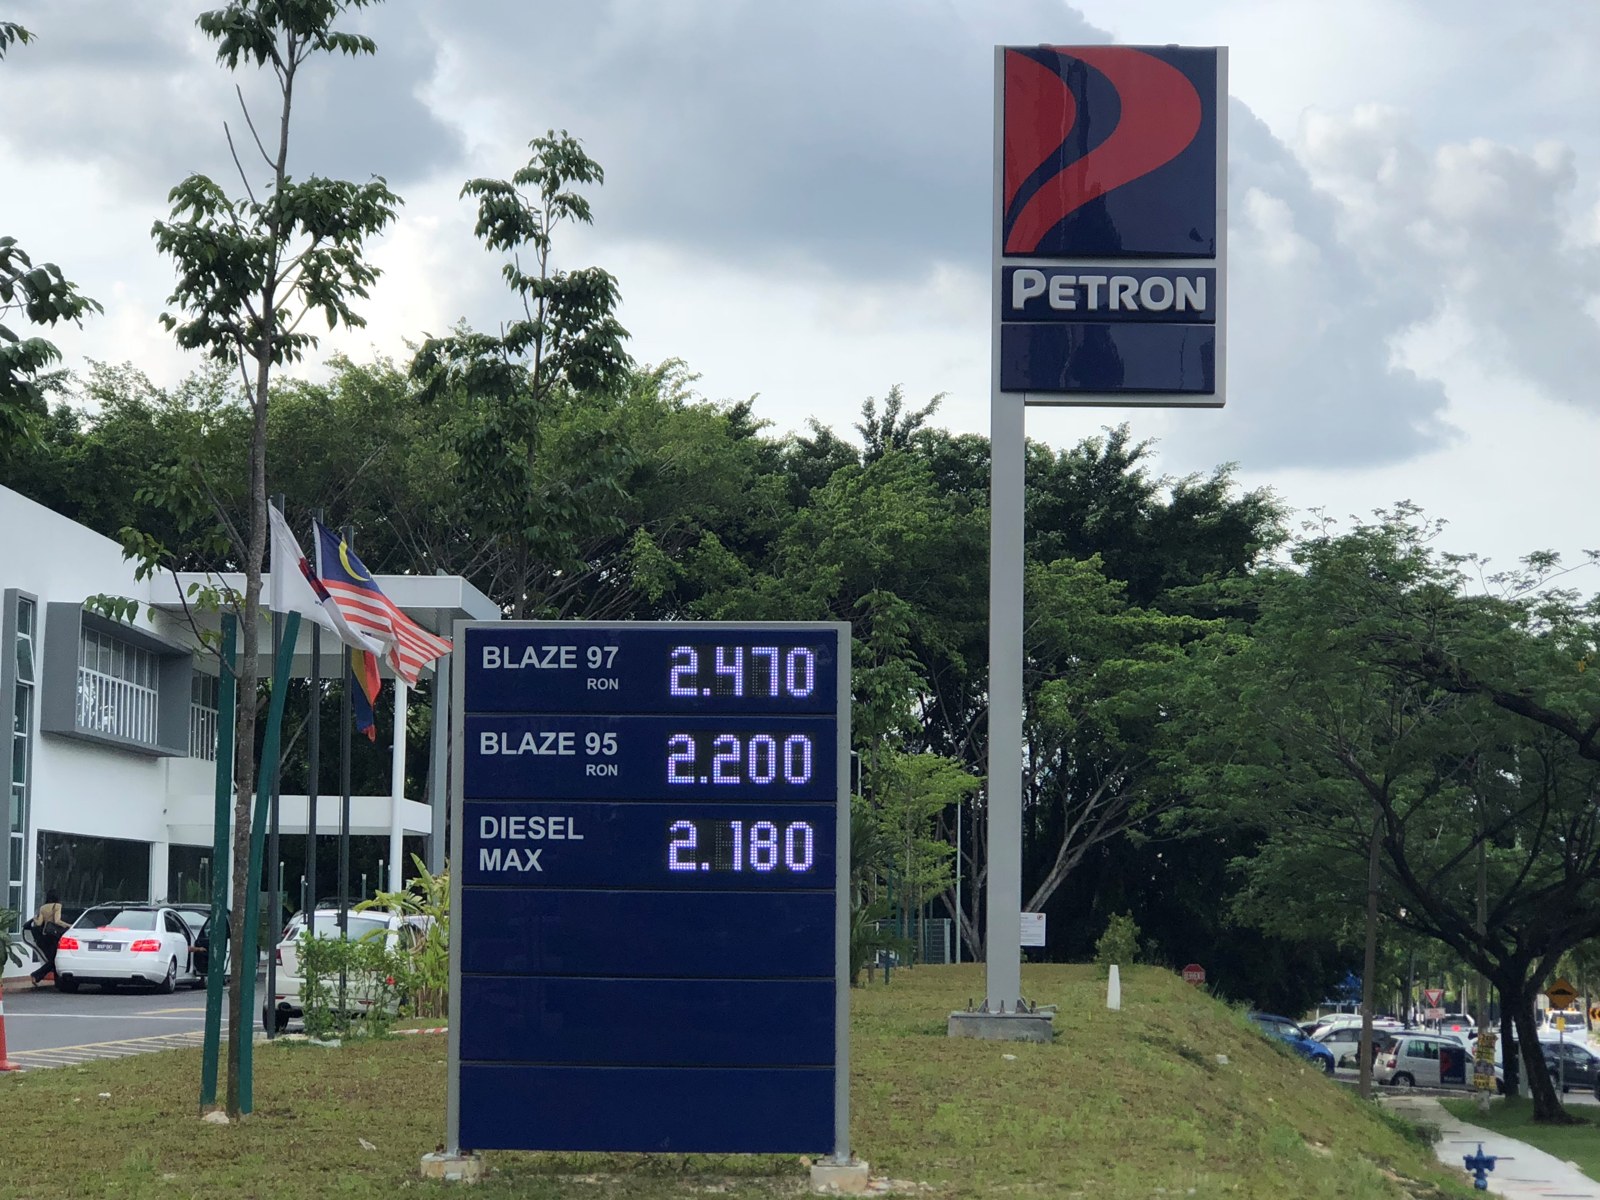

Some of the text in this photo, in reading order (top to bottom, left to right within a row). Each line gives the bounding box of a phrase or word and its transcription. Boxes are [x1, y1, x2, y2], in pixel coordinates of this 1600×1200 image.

[1012, 269, 1207, 311] PETRON
[482, 646, 619, 669] BLAZE 97
[670, 646, 814, 697] 2.470
[587, 678, 619, 690] RON
[480, 732, 618, 755] BLAZE 95
[586, 764, 618, 776] RON
[668, 734, 812, 784] 2.200
[480, 816, 584, 840] DIESEL
[669, 820, 814, 872] 2.180
[479, 848, 543, 872] MAX
